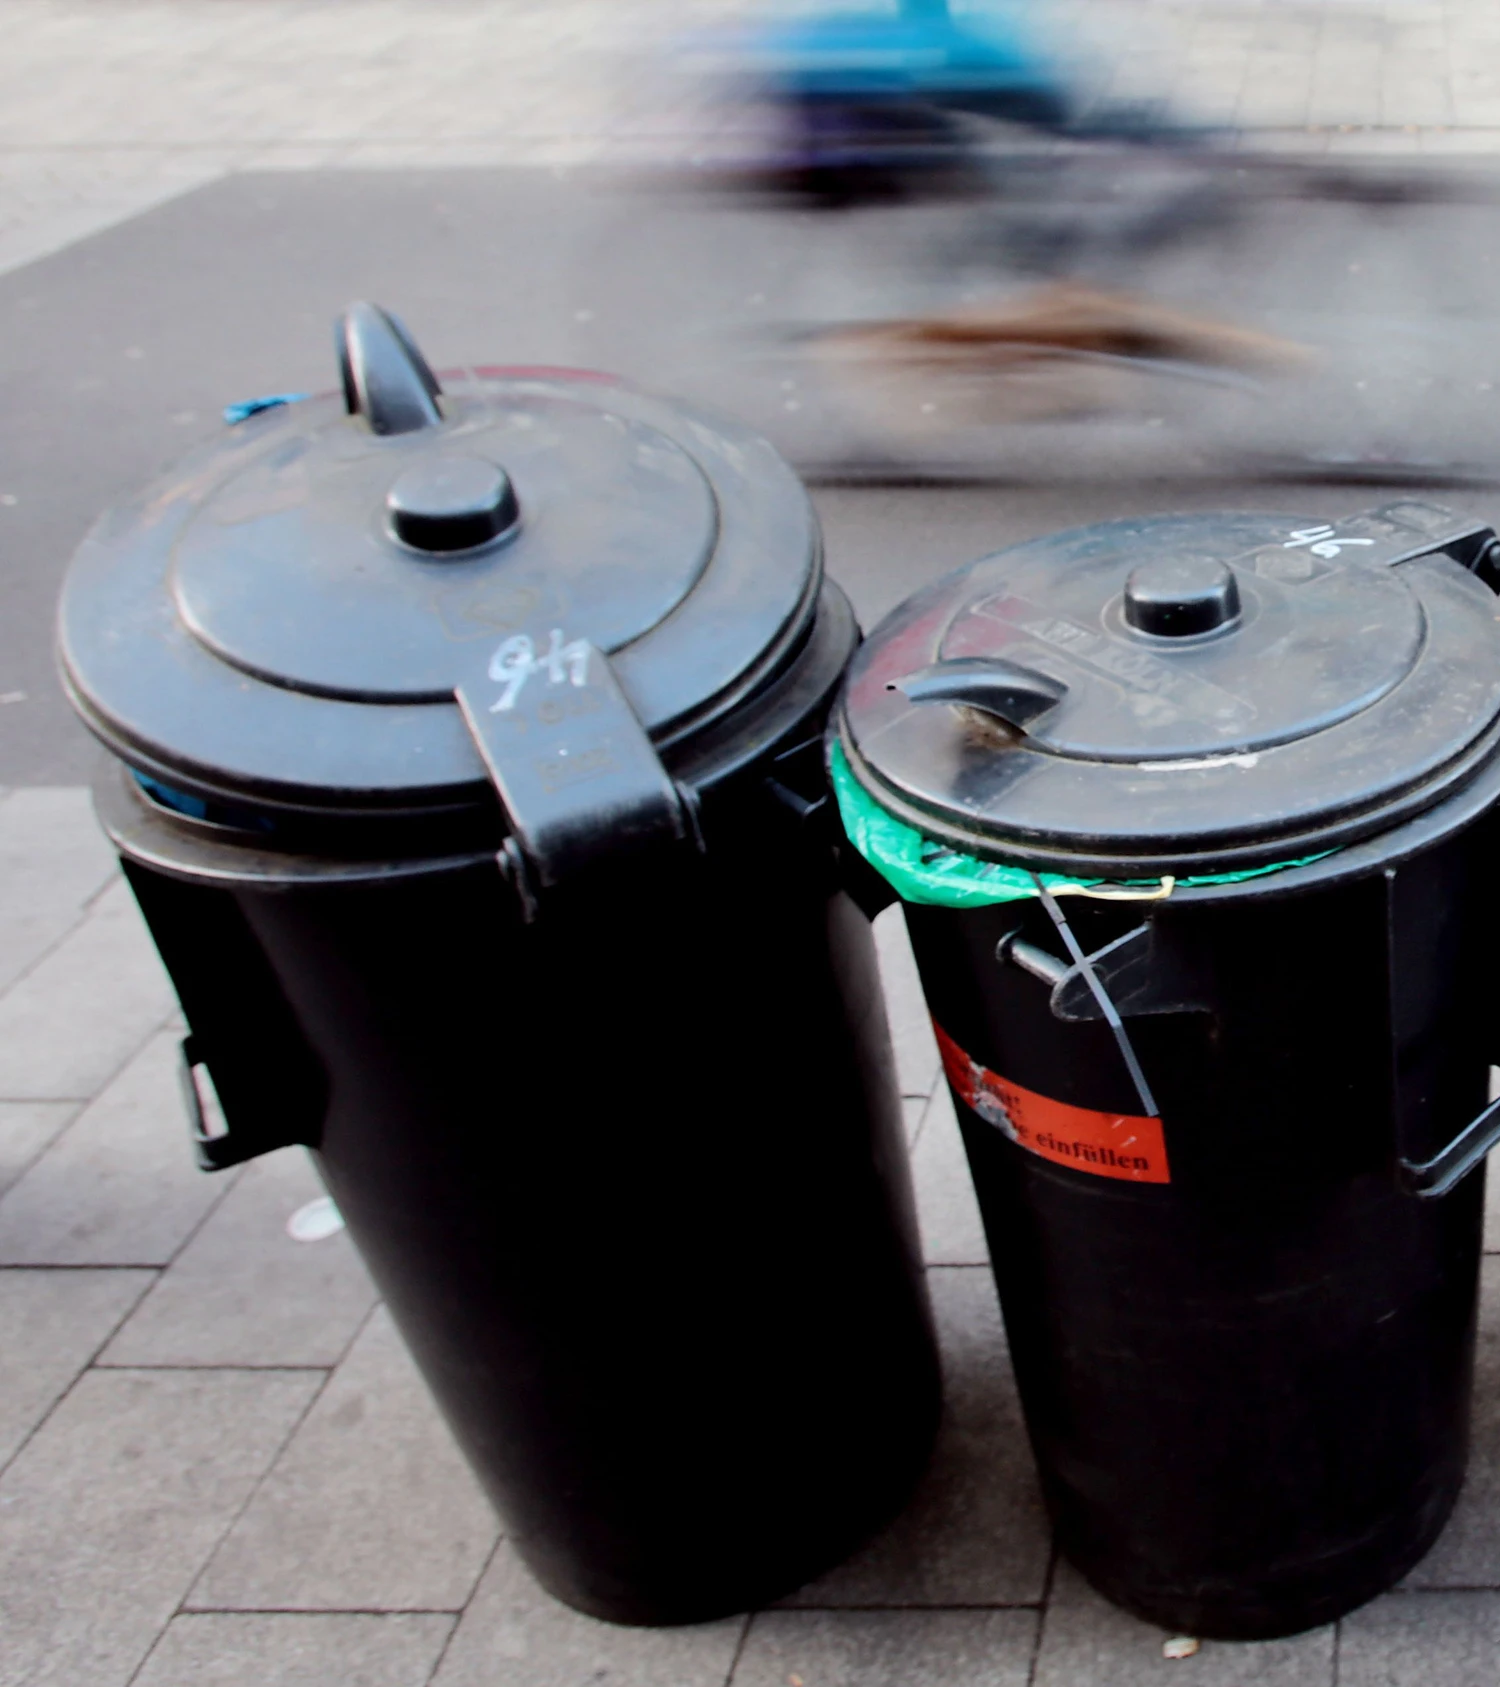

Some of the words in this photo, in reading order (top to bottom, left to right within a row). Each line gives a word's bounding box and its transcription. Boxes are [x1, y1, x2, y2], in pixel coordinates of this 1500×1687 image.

[1283, 524, 1375, 559] 46
[488, 628, 591, 713] 46
[1036, 1131, 1150, 1171] einfüllen
